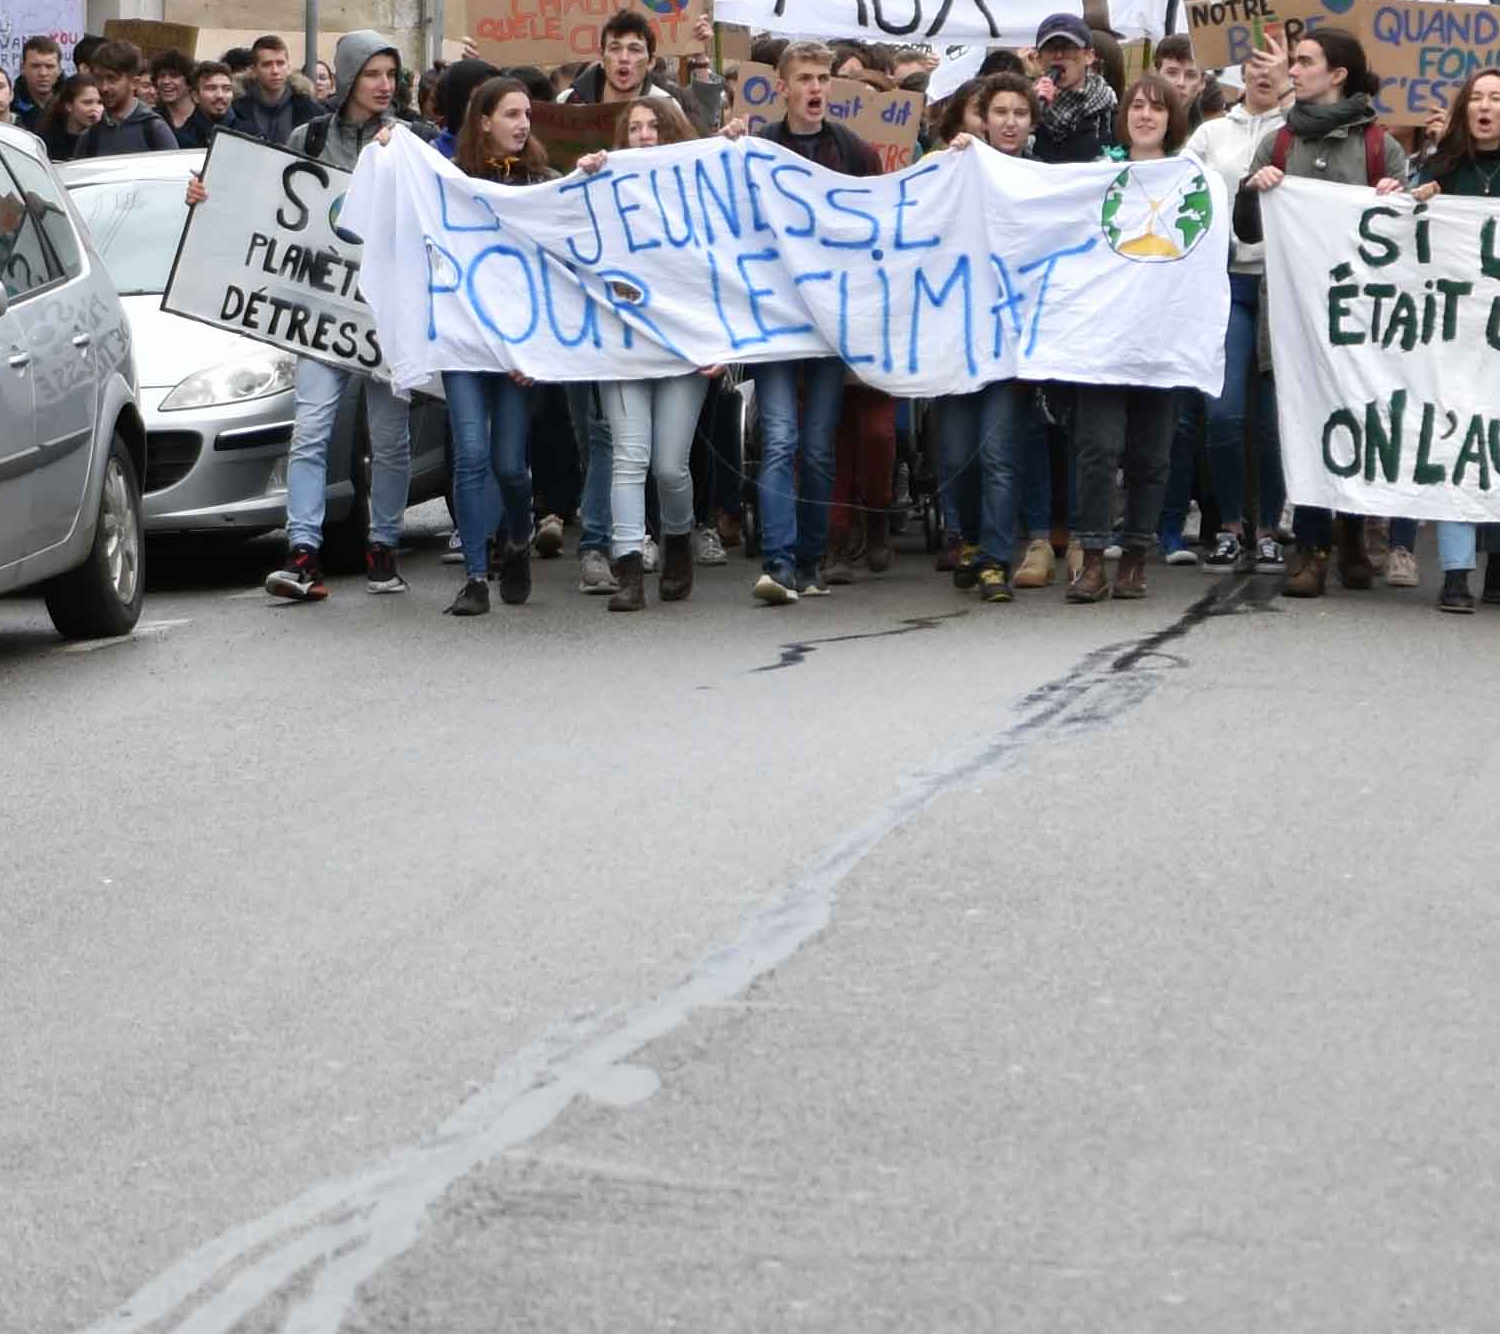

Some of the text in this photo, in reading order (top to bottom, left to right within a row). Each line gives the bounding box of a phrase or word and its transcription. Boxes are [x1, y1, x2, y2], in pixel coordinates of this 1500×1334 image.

[1373, 5, 1500, 47] QUAND
[826, 95, 863, 119] ait
[1372, 76, 1461, 113] C'ES
[560, 151, 941, 265] JEUNESSE
[220, 285, 382, 367] DÉTRESS
[424, 234, 700, 364] POUR
[708, 246, 815, 349] LE
[1321, 388, 1408, 485] ON
